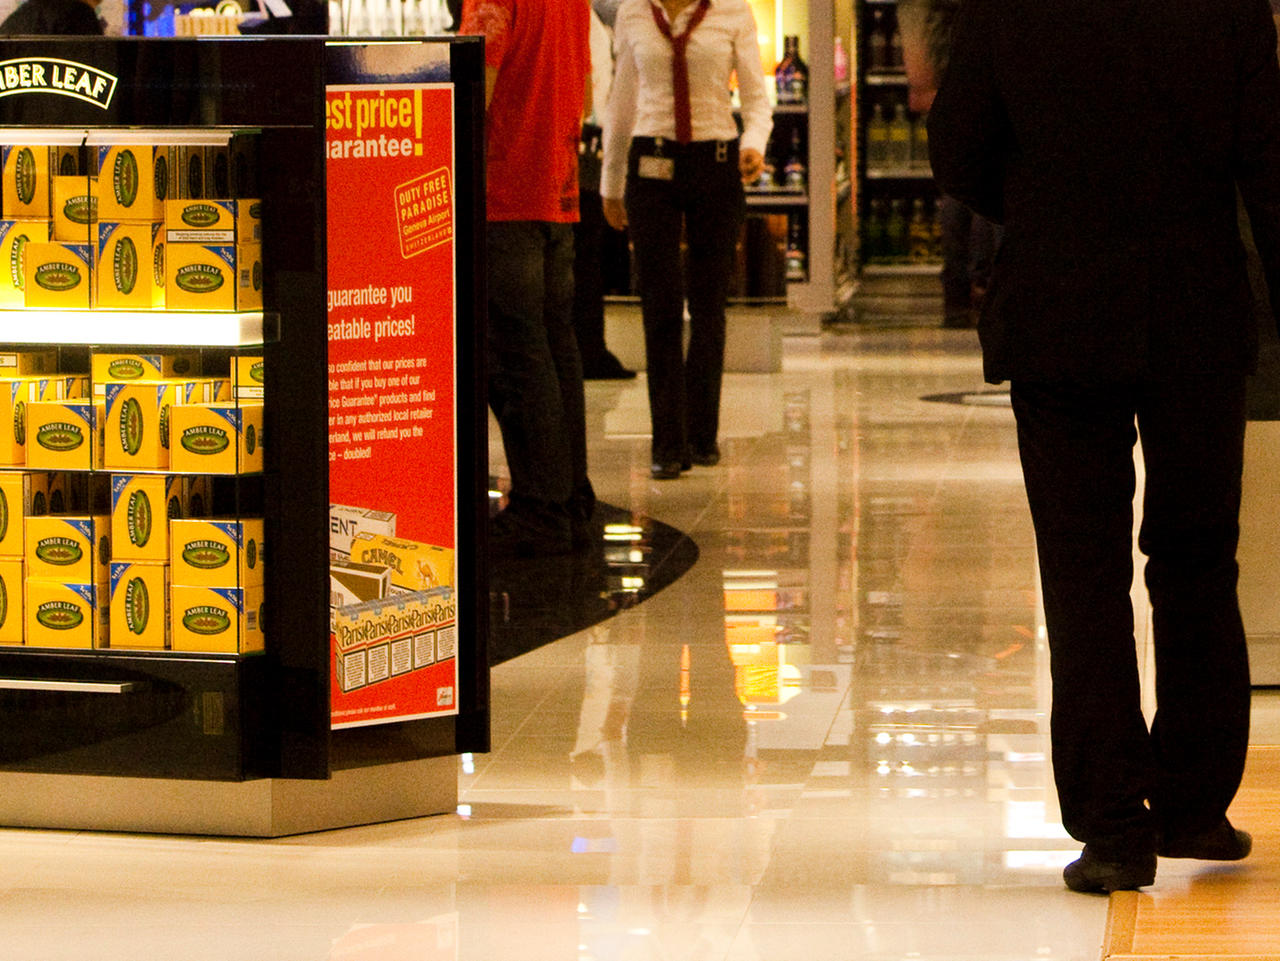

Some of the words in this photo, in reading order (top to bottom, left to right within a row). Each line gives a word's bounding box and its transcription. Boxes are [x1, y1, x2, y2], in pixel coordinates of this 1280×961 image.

[52, 64, 107, 99] LEAF
[399, 185, 421, 206] DUTY
[423, 175, 447, 197] FREE
[401, 191, 449, 221] PARADISE
[39, 265, 61, 274] AMBER
[180, 265, 203, 276] AMBER
[203, 265, 219, 276] LEAF
[327, 284, 387, 312] guarantee
[390, 286, 413, 309] you
[327, 317, 371, 341] eatable
[374, 314, 416, 343] prices!
[336, 360, 367, 373] confident
[368, 359, 382, 371] that
[382, 360, 393, 370] our
[394, 357, 415, 372] prices
[416, 358, 427, 368] are
[340, 378, 353, 390] that
[361, 379, 373, 391] you
[374, 376, 386, 390] buy
[387, 377, 400, 387] one
[401, 374, 408, 386] of
[408, 375, 420, 386] our
[379, 391, 408, 408] products
[409, 390, 422, 403] and
[422, 389, 436, 401] find
[337, 413, 344, 425] in
[345, 415, 357, 427] any
[358, 410, 393, 425] authorized
[393, 408, 409, 421] local
[410, 407, 433, 420] retailer
[185, 426, 208, 437] AMBER
[208, 426, 225, 437] LEAF
[352, 431, 363, 442] we
[363, 428, 376, 441] will
[377, 426, 398, 440] refund
[399, 428, 412, 441] you
[412, 425, 424, 437] the
[331, 516, 358, 537] ENT
[40, 538, 61, 547] AMBER
[186, 541, 209, 551] AMBER
[209, 541, 226, 551] LEAF
[361, 548, 404, 576] CAMEL
[41, 602, 62, 611] AMBER
[186, 606, 209, 617] AMBER
